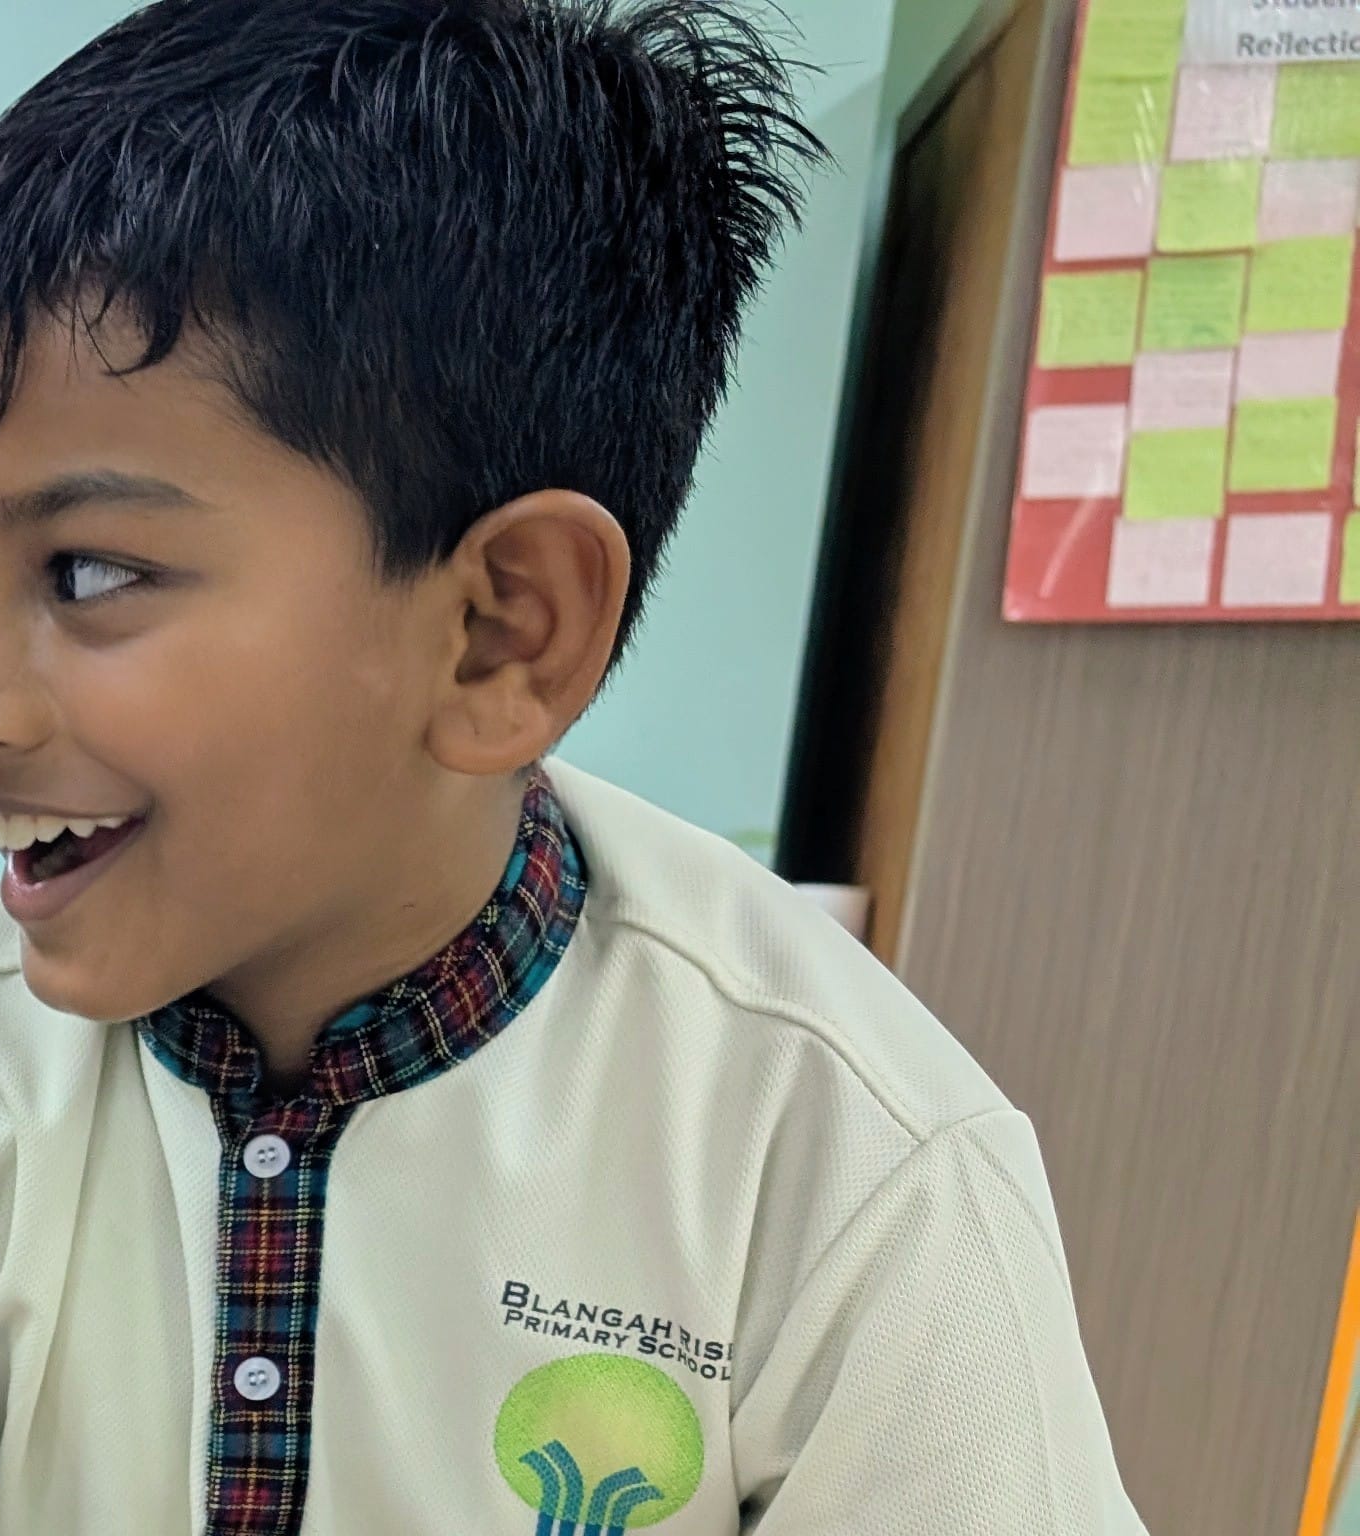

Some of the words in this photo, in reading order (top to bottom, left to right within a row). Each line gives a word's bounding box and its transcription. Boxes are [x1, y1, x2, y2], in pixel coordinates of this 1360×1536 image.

[500, 1280, 671, 1339] BLANGAH
[503, 1309, 630, 1349] PRIMARY
[637, 1335, 732, 1381] SCHOOL
